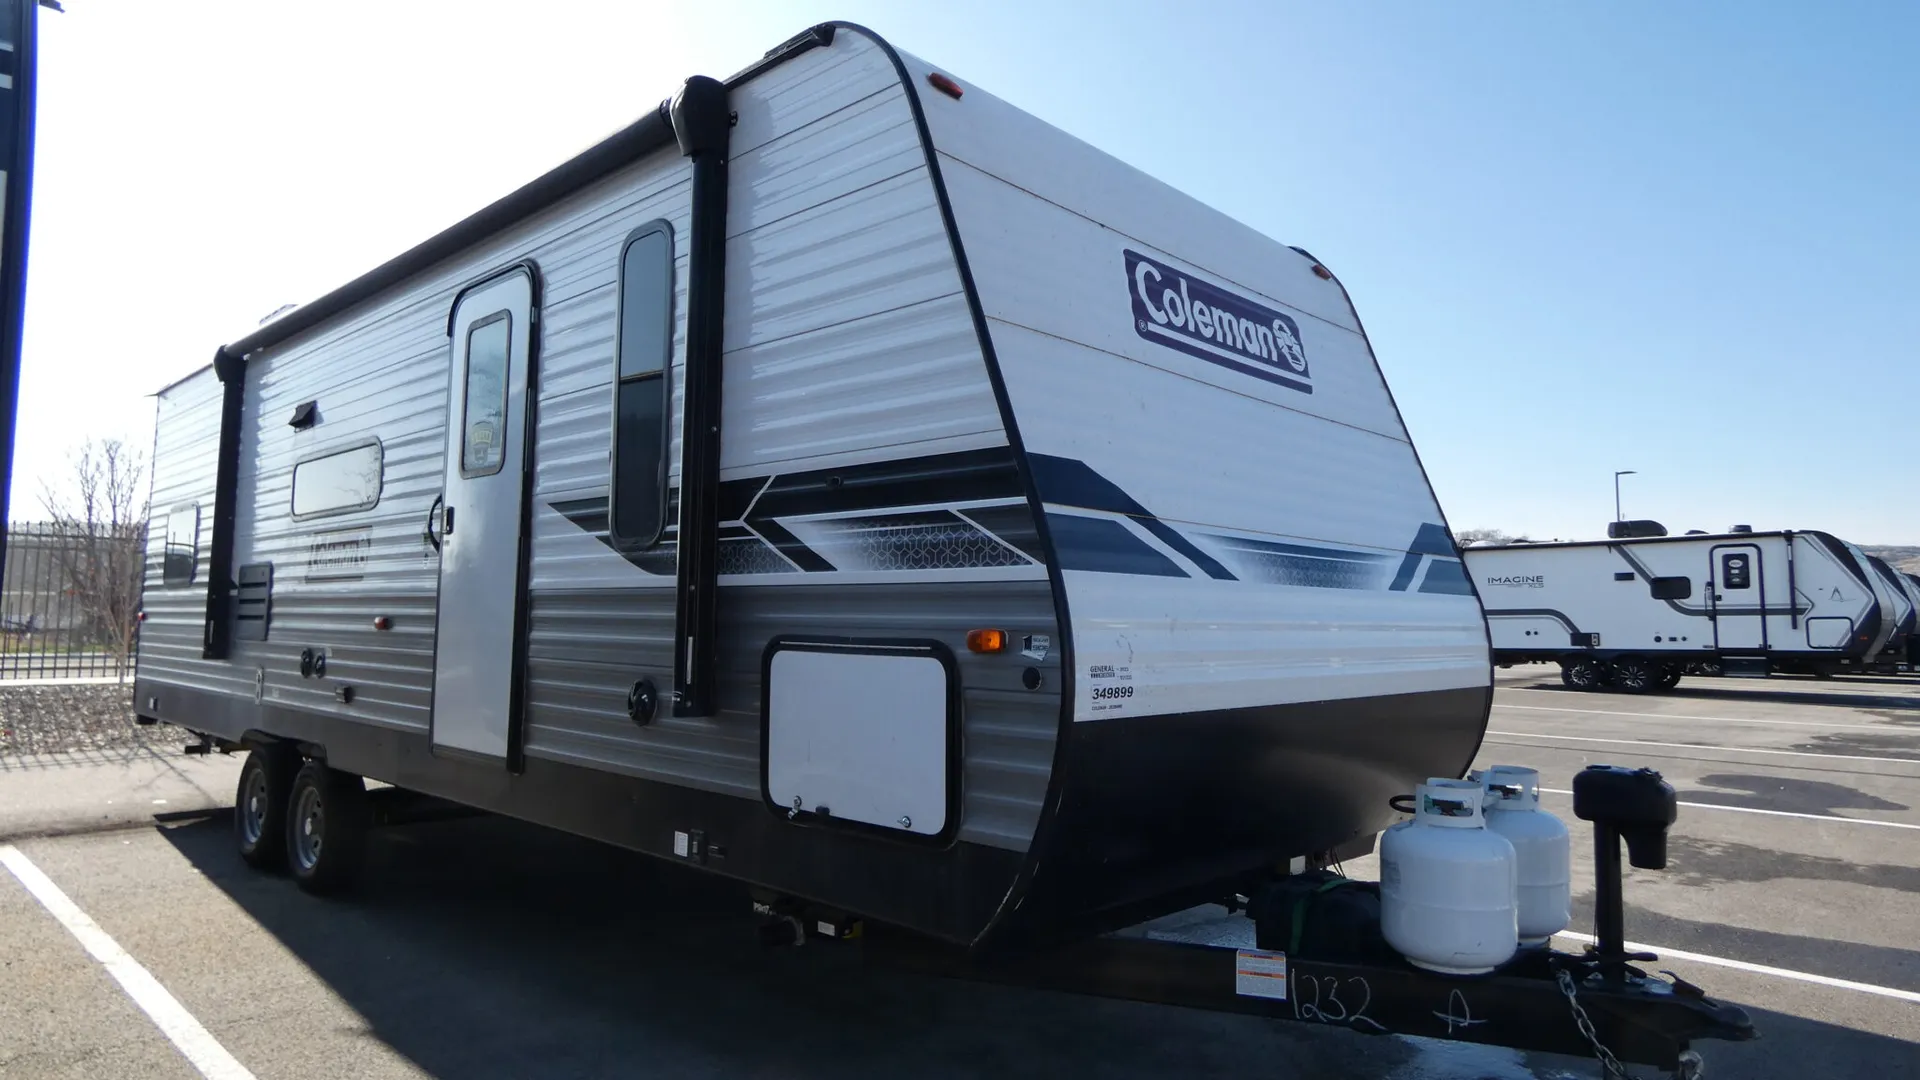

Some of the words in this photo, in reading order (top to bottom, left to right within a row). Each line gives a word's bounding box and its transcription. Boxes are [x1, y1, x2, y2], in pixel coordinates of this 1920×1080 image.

[1135, 261, 1278, 362] Coleman
[1487, 575, 1544, 584] IMAGINE
[1090, 665, 1115, 673] GENERAL
[1092, 686, 1134, 700] 349899
[1291, 968, 1387, 1031] 1232
